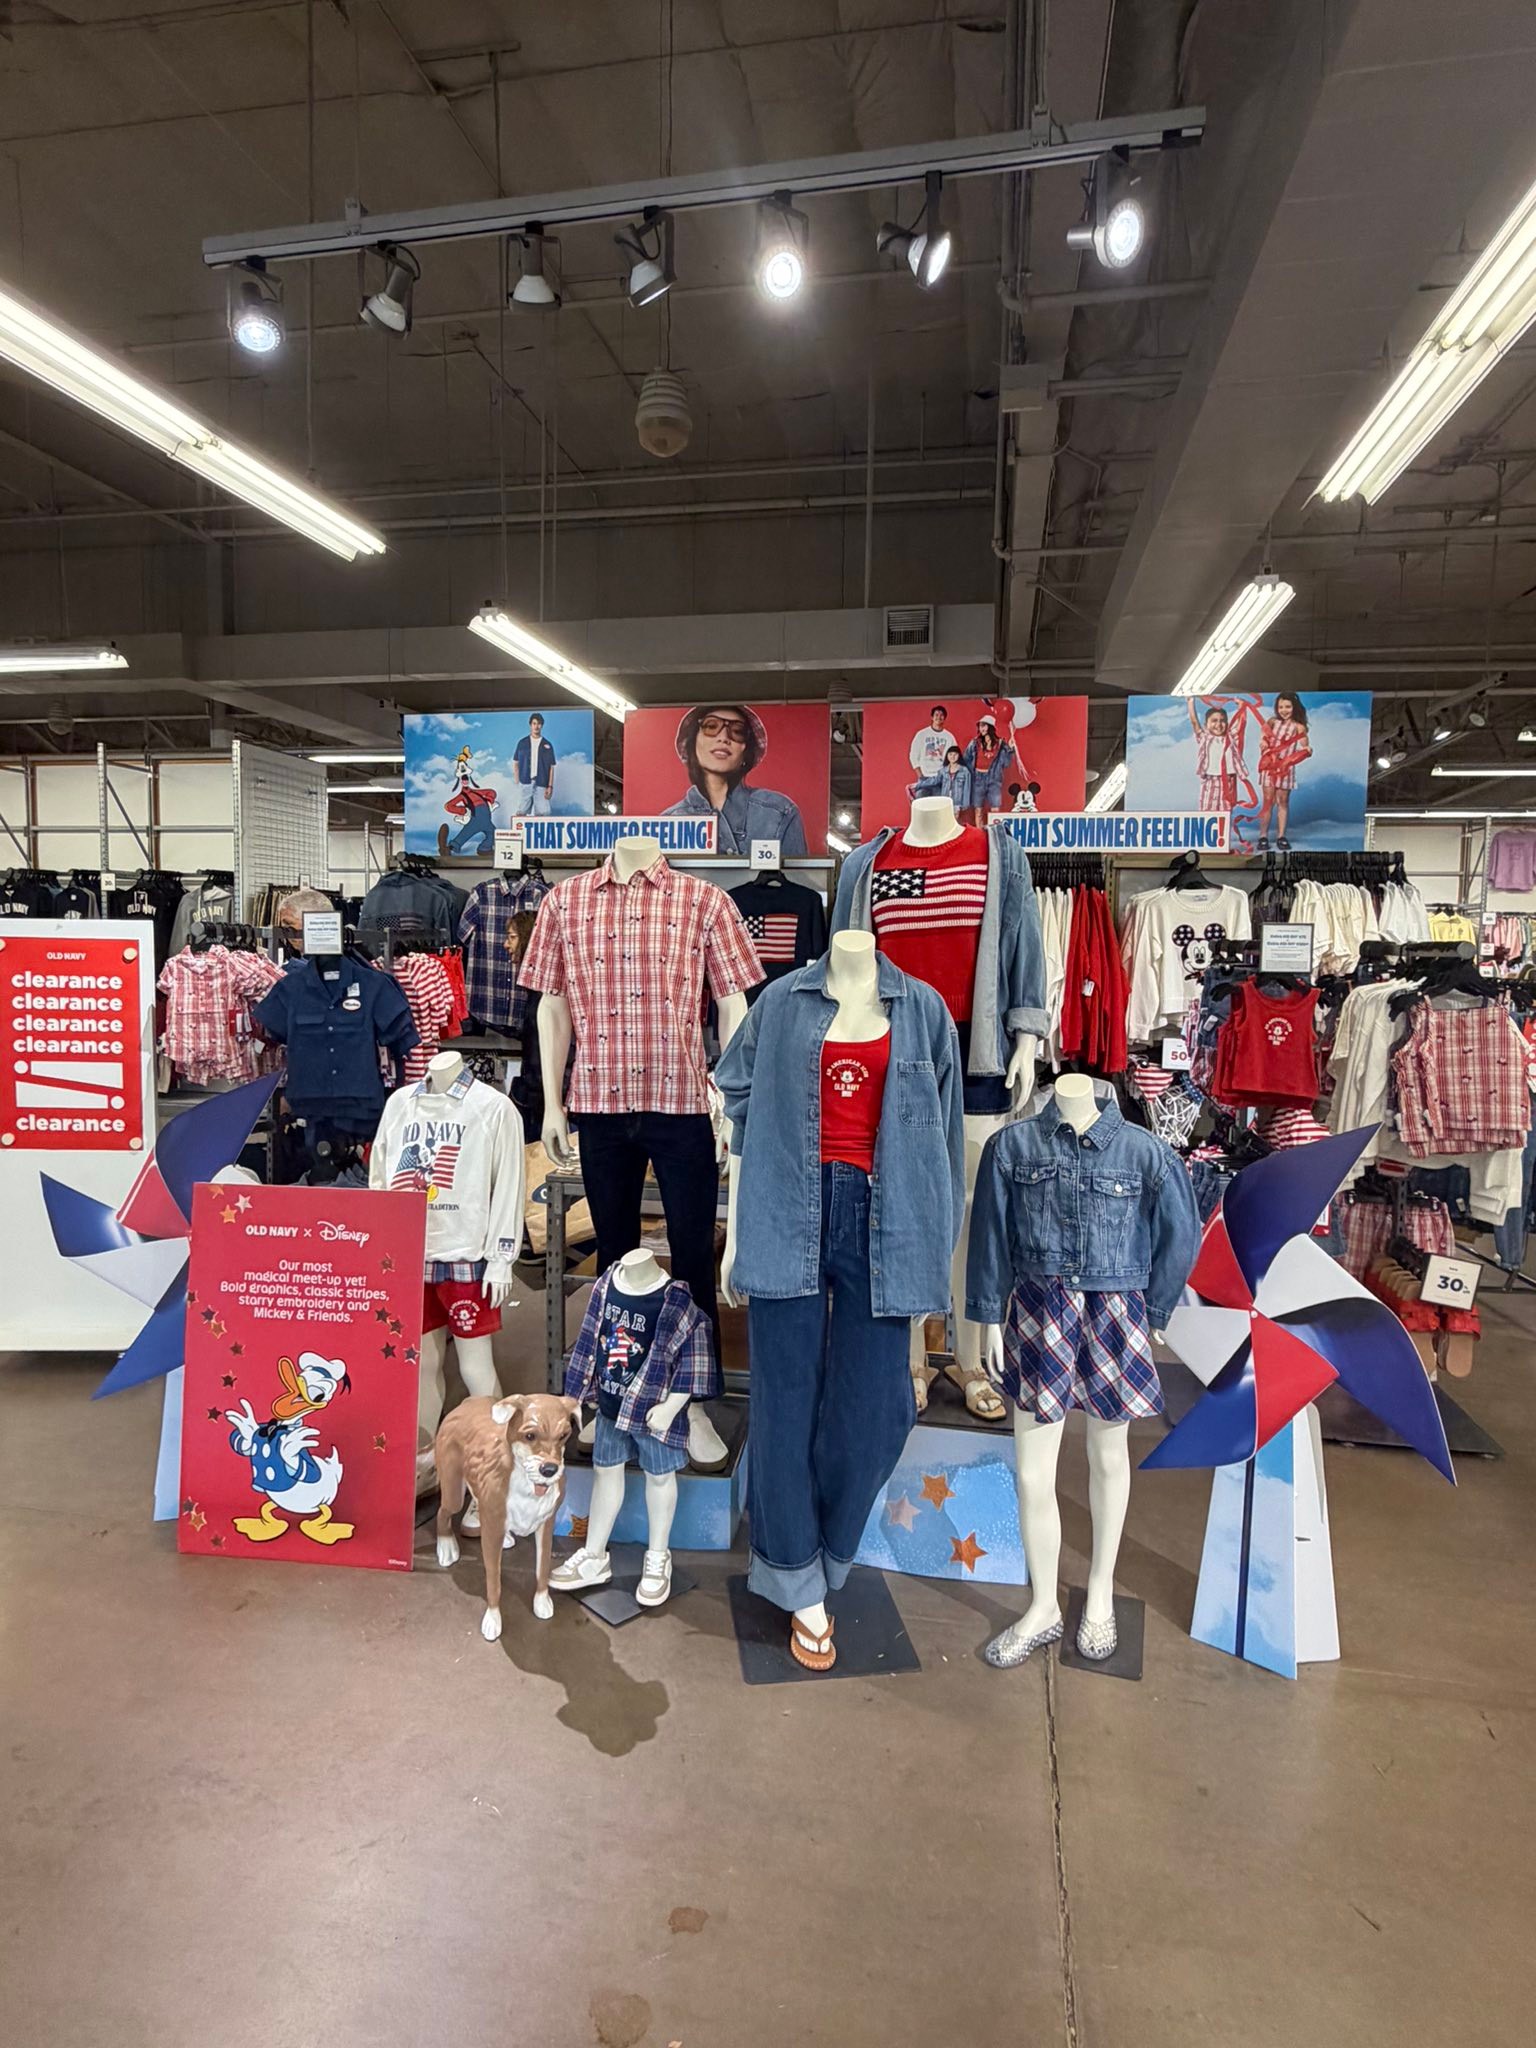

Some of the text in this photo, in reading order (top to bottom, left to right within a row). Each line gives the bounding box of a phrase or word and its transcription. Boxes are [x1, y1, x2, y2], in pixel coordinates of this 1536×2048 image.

[524, 821, 565, 849] THAT
[641, 820, 713, 849] FEELING!
[1051, 817, 1138, 848] SUMMER
[1143, 816, 1226, 848] FEELING!
[758, 850, 773, 859] 30
[46, 952, 87, 961] OLD NAVY
[11, 970, 123, 990] clearance
[11, 992, 123, 1012] clearance
[12, 1014, 124, 1033] clearance
[12, 1035, 124, 1055] clearance
[1170, 1051, 1187, 1061] 50
[15, 1113, 126, 1132] clearance
[426, 1121, 467, 1144] NAVY
[245, 1224, 268, 1236] OLD
[269, 1225, 299, 1238] NAVY
[317, 1220, 370, 1248] Disney
[279, 1259, 333, 1273] Our most
[243, 1271, 367, 1288] magical meet-up yet!
[1437, 1275, 1463, 1292] 30
[220, 1281, 390, 1301] Bold graphics, classic stripes,
[238, 1295, 370, 1312] starry embroidery and
[253, 1306, 354, 1323] Mickey & Friends.
[604, 1302, 647, 1332] STAR
